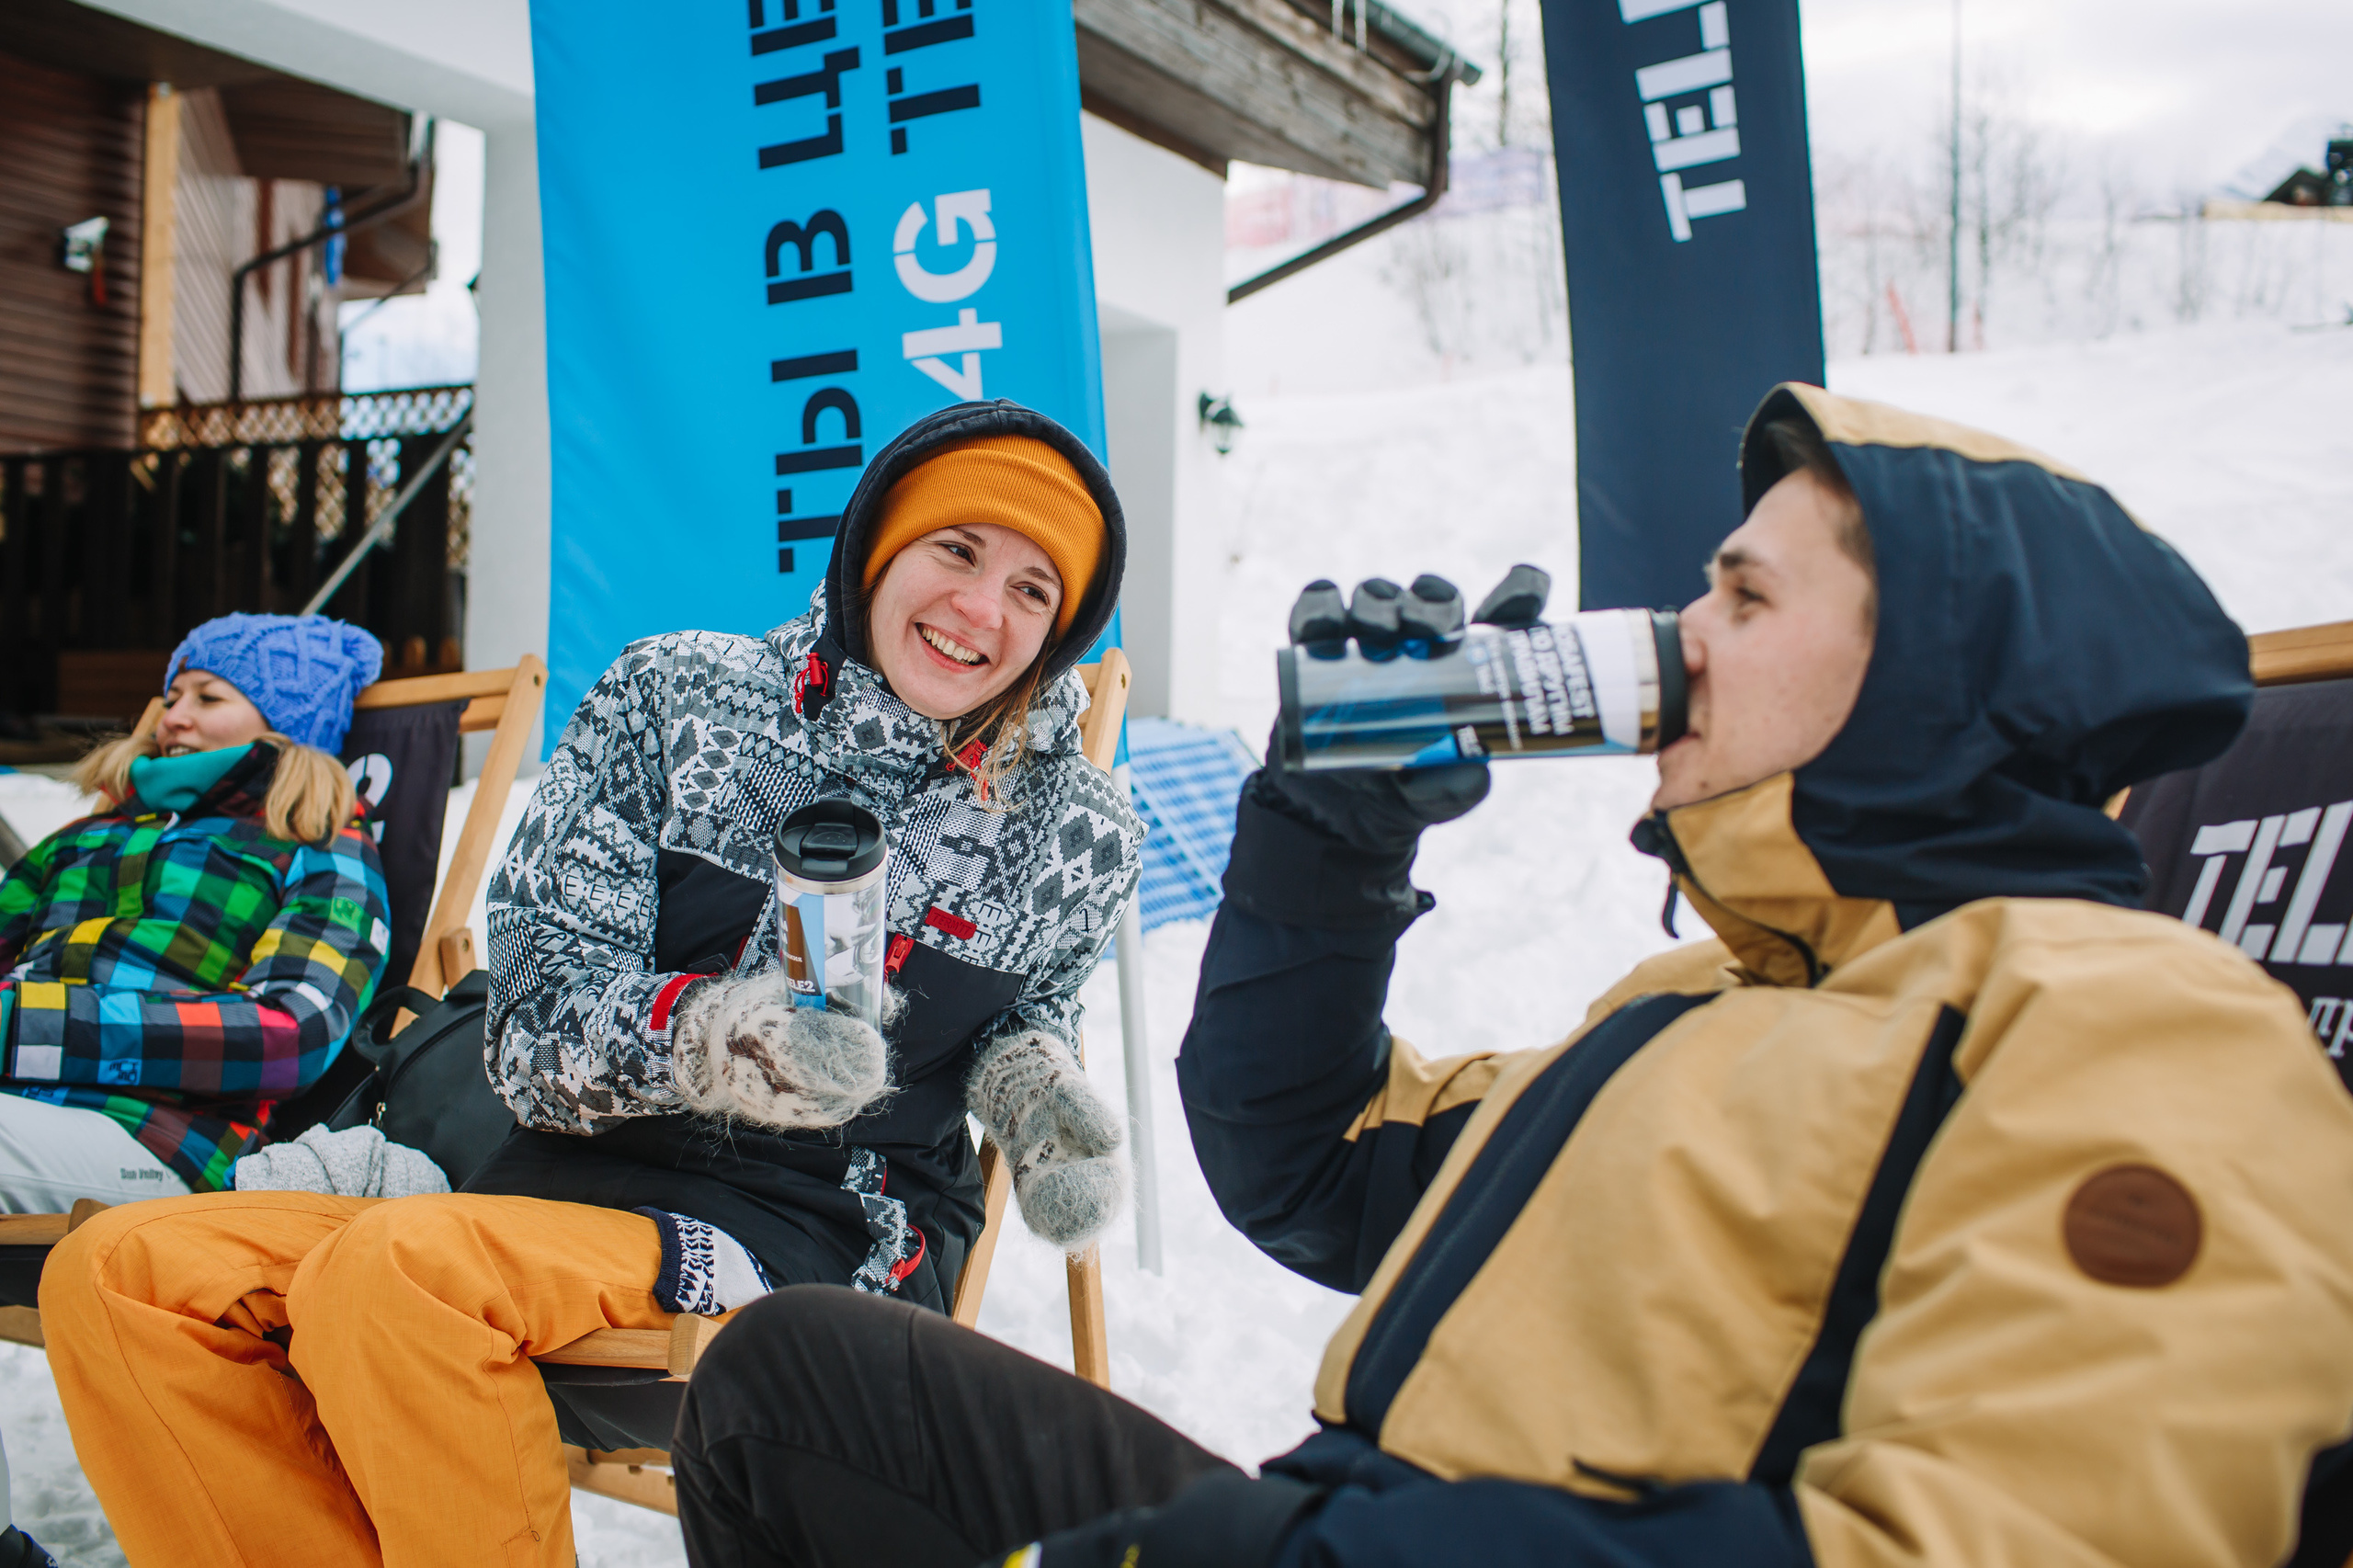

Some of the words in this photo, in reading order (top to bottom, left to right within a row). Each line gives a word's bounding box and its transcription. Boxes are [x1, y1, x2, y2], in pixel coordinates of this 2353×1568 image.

[1617, 0, 1746, 243] TEL
[765, 208, 853, 306] В
[892, 188, 1003, 402] 4G
[770, 347, 864, 573] ТЫ
[2181, 800, 2353, 965] TEL
